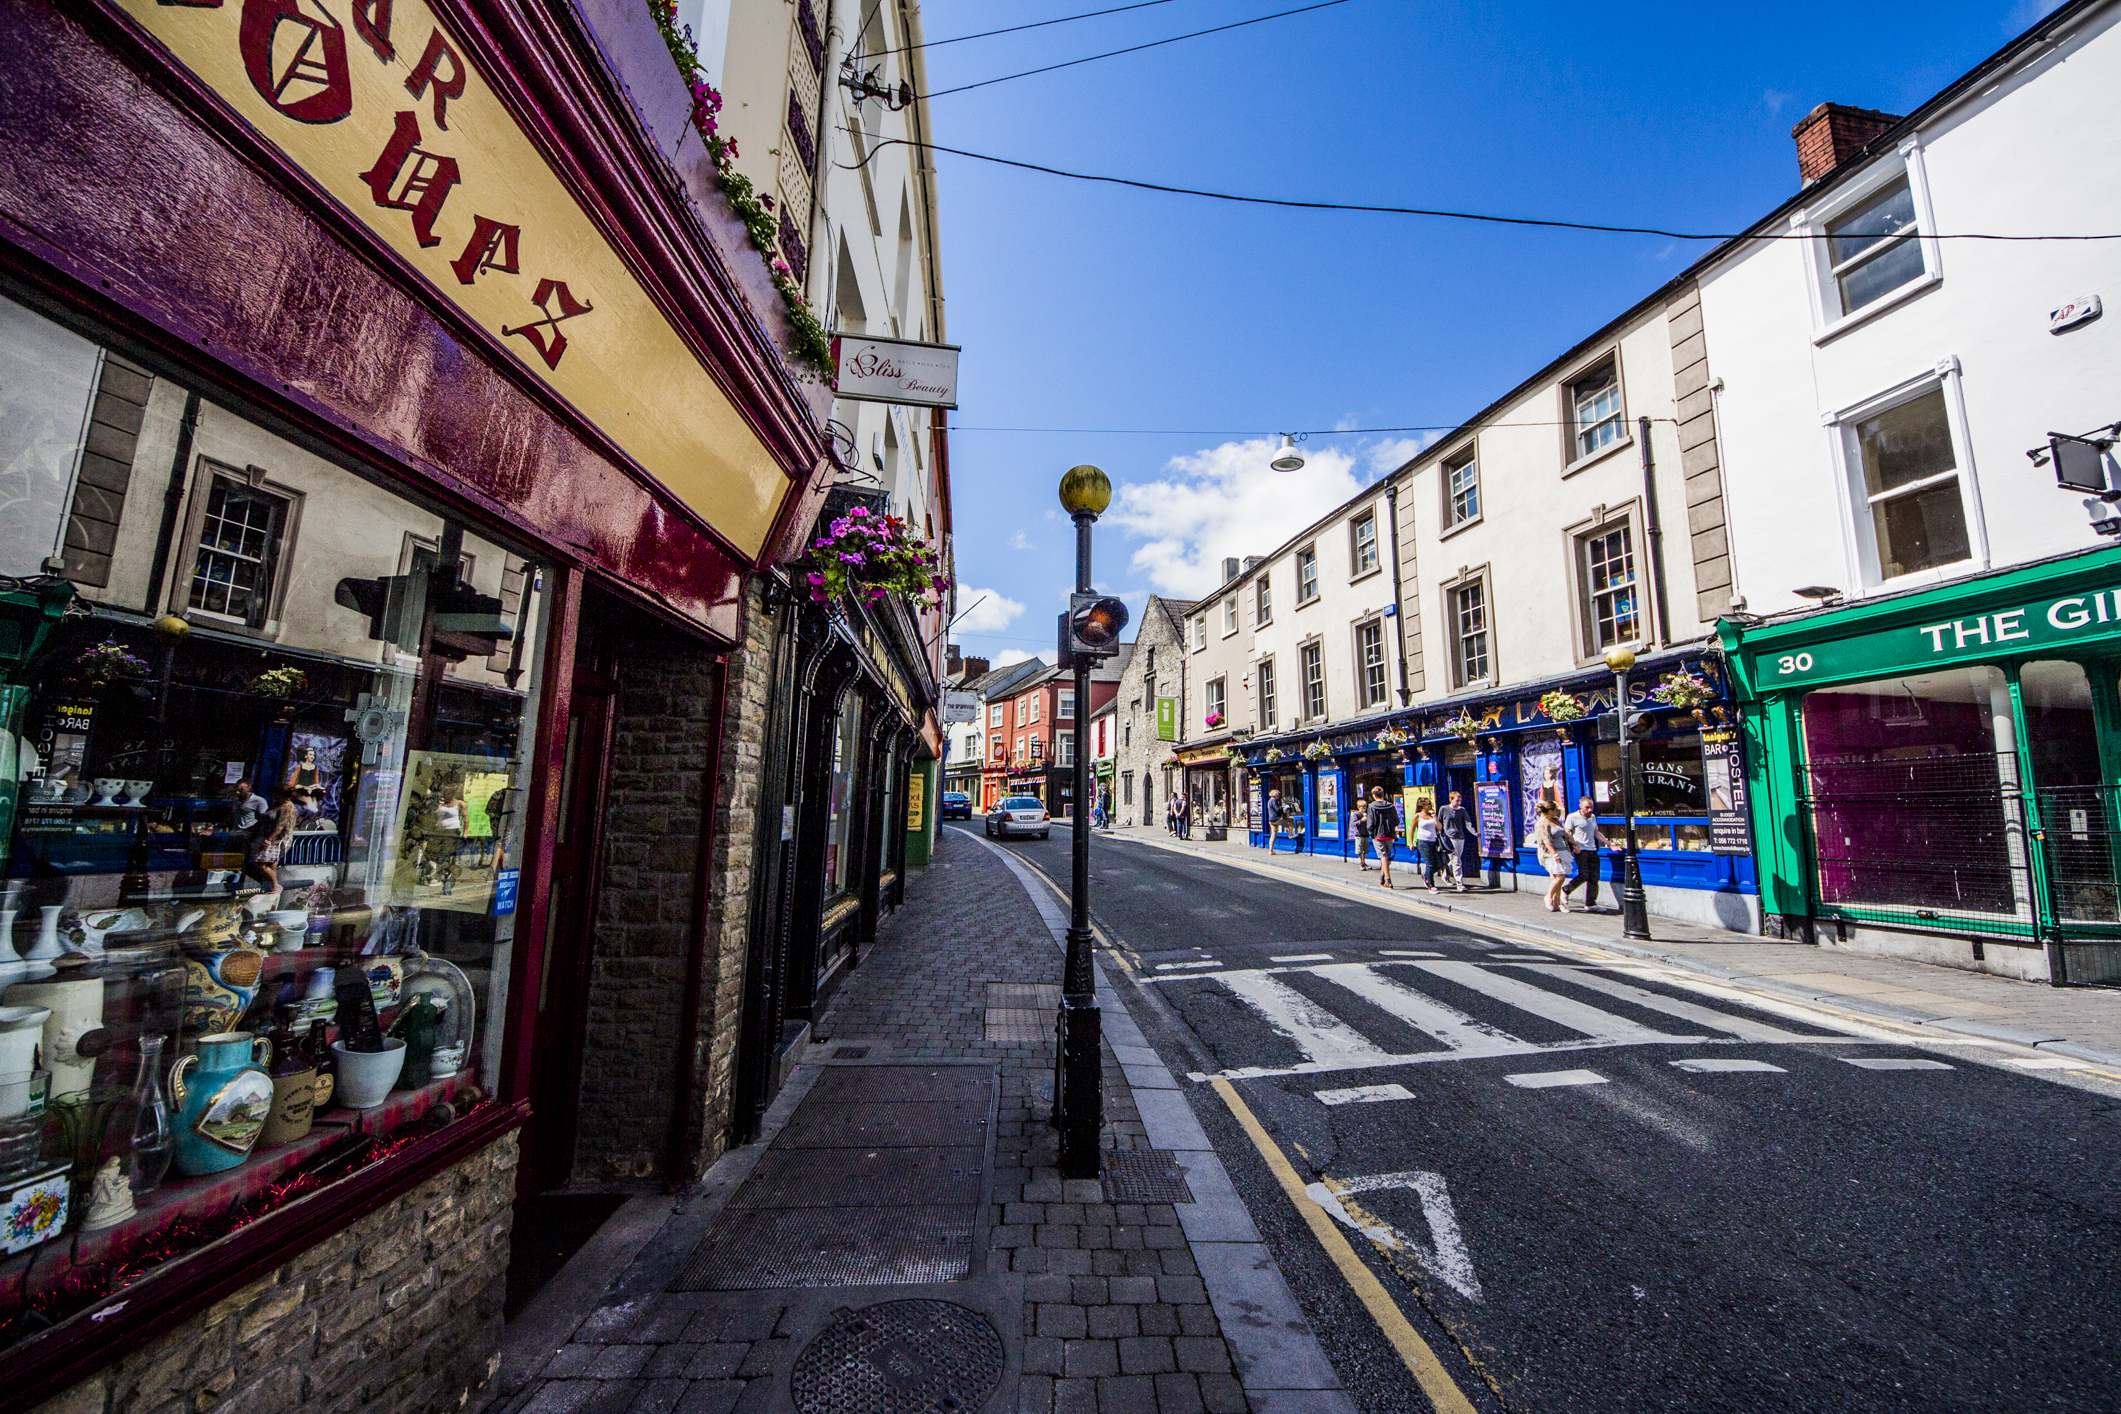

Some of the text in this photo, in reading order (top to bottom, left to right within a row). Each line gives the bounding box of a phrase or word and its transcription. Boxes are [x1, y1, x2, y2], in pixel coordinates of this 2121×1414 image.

[845, 345, 907, 379] Bliss
[897, 379, 950, 399] Beauty
[1920, 608, 2030, 653] THE
[1778, 652, 1814, 675] 30
[1702, 731, 1737, 742] Lanigan's
[1704, 744, 1722, 755] BAR
[1728, 741, 1745, 811] HOSTEL
[1713, 828, 1731, 836] enquire
[499, 880, 516, 889] BUSINESS
[497, 899, 514, 910] WATCH
